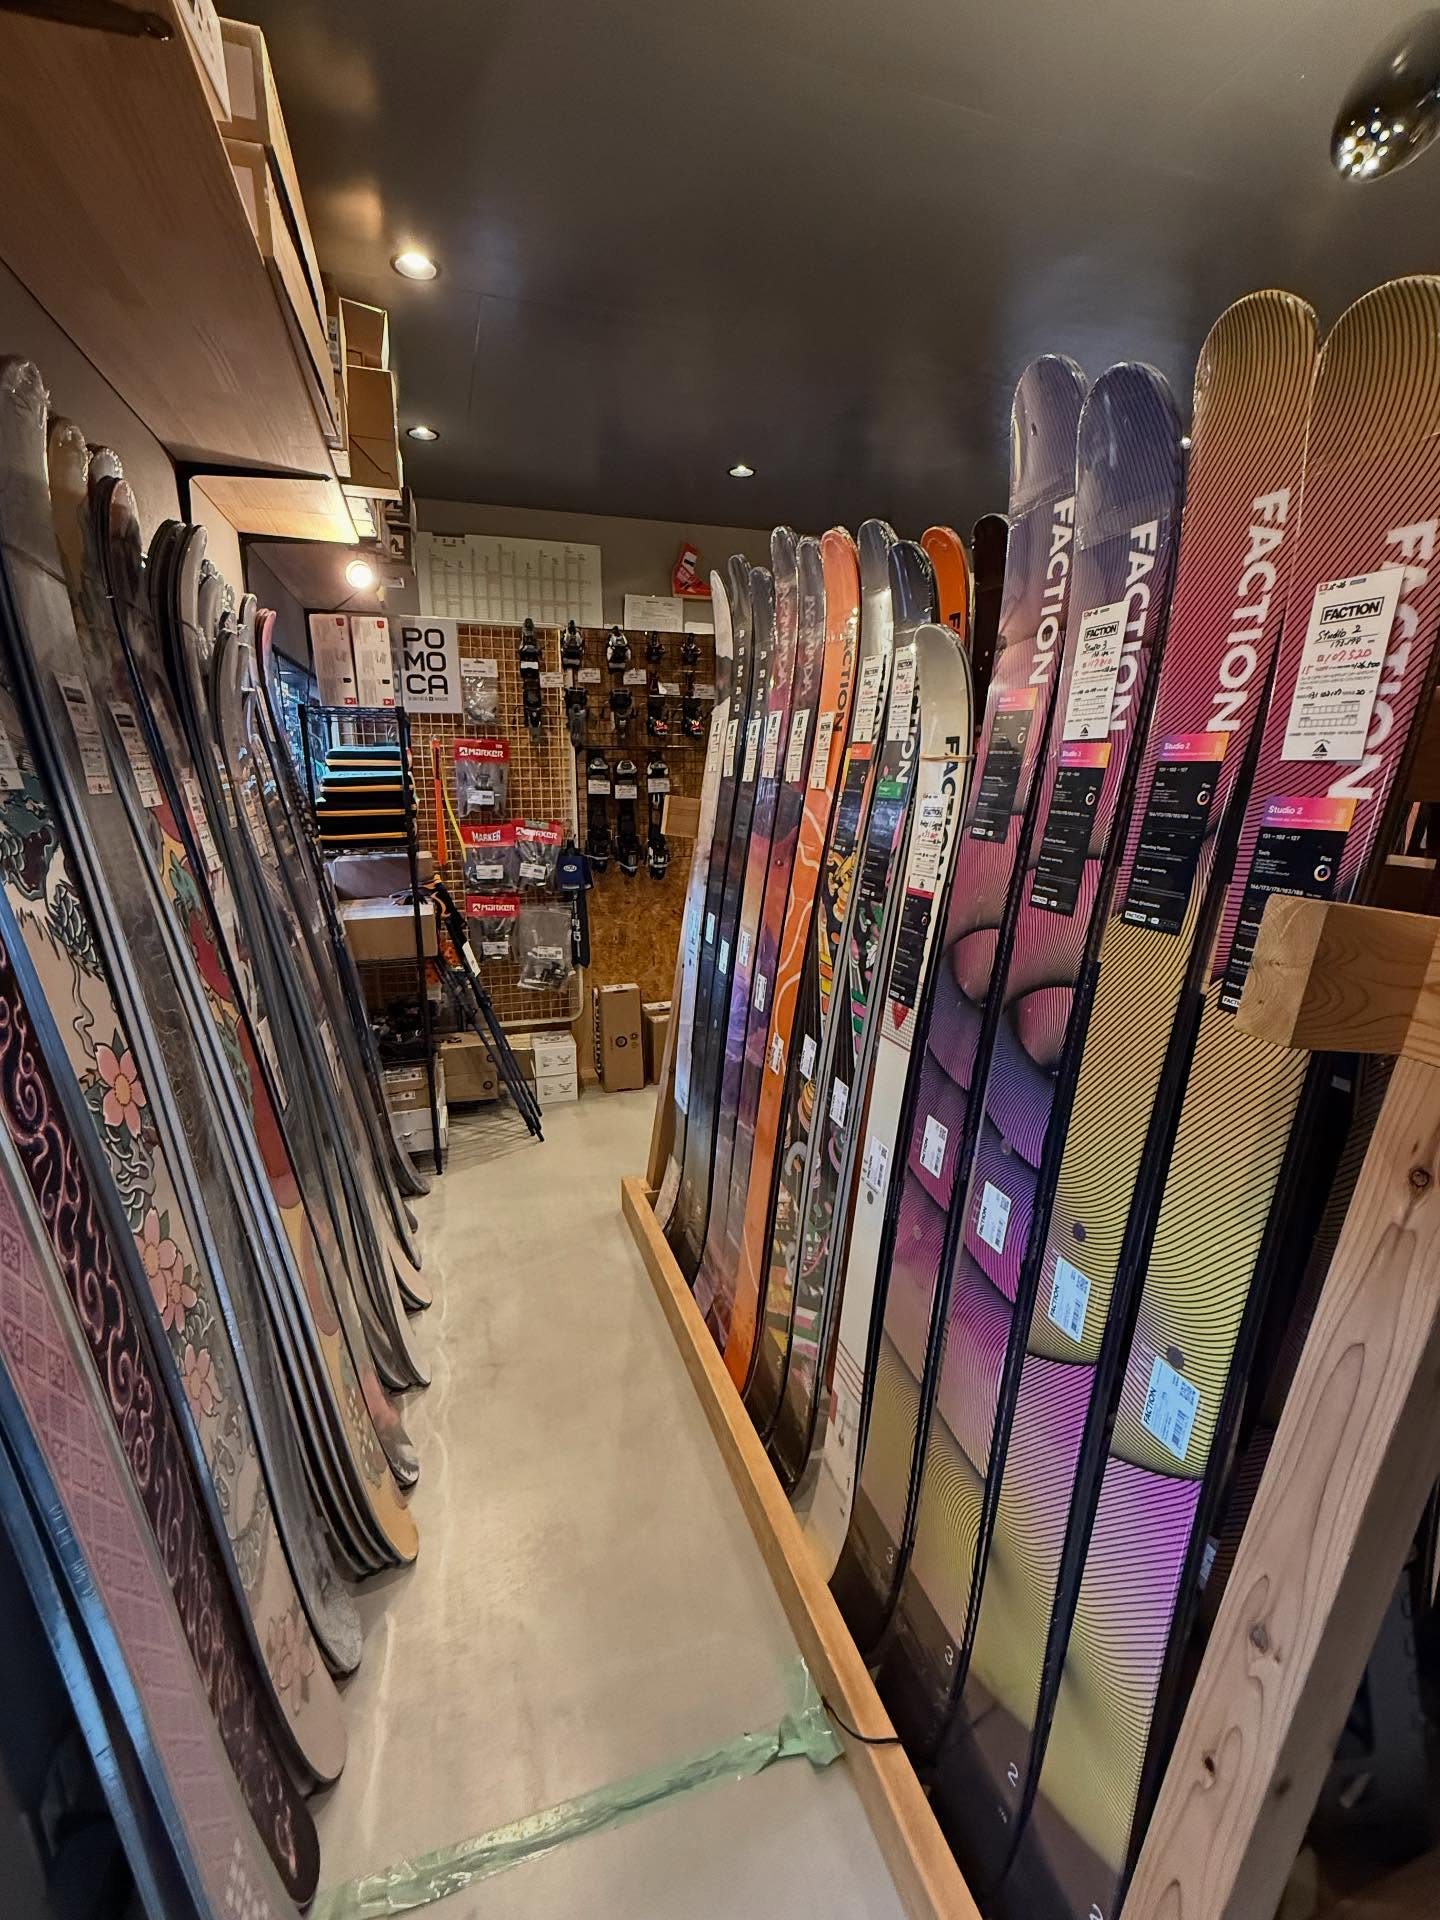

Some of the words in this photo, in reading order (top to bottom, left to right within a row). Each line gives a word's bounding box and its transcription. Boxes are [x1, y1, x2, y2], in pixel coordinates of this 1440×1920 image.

[1029, 496, 1076, 685] FACTION
[1206, 487, 1291, 732] FACTION
[1323, 601, 1381, 621] FACTION
[402, 627, 445, 649] PO
[1086, 624, 1117, 639] FACTION
[1316, 627, 1347, 642] Studio
[1352, 624, 1362, 634] 2
[404, 651, 447, 672] MO
[406, 674, 449, 695] CA
[1268, 805, 1296, 815] Studio
[1296, 806, 1304, 815] 2
[472, 830, 501, 842] MARKER
[1050, 1283, 1060, 1318] FACTION
[1143, 1386, 1157, 1425] FACTION
